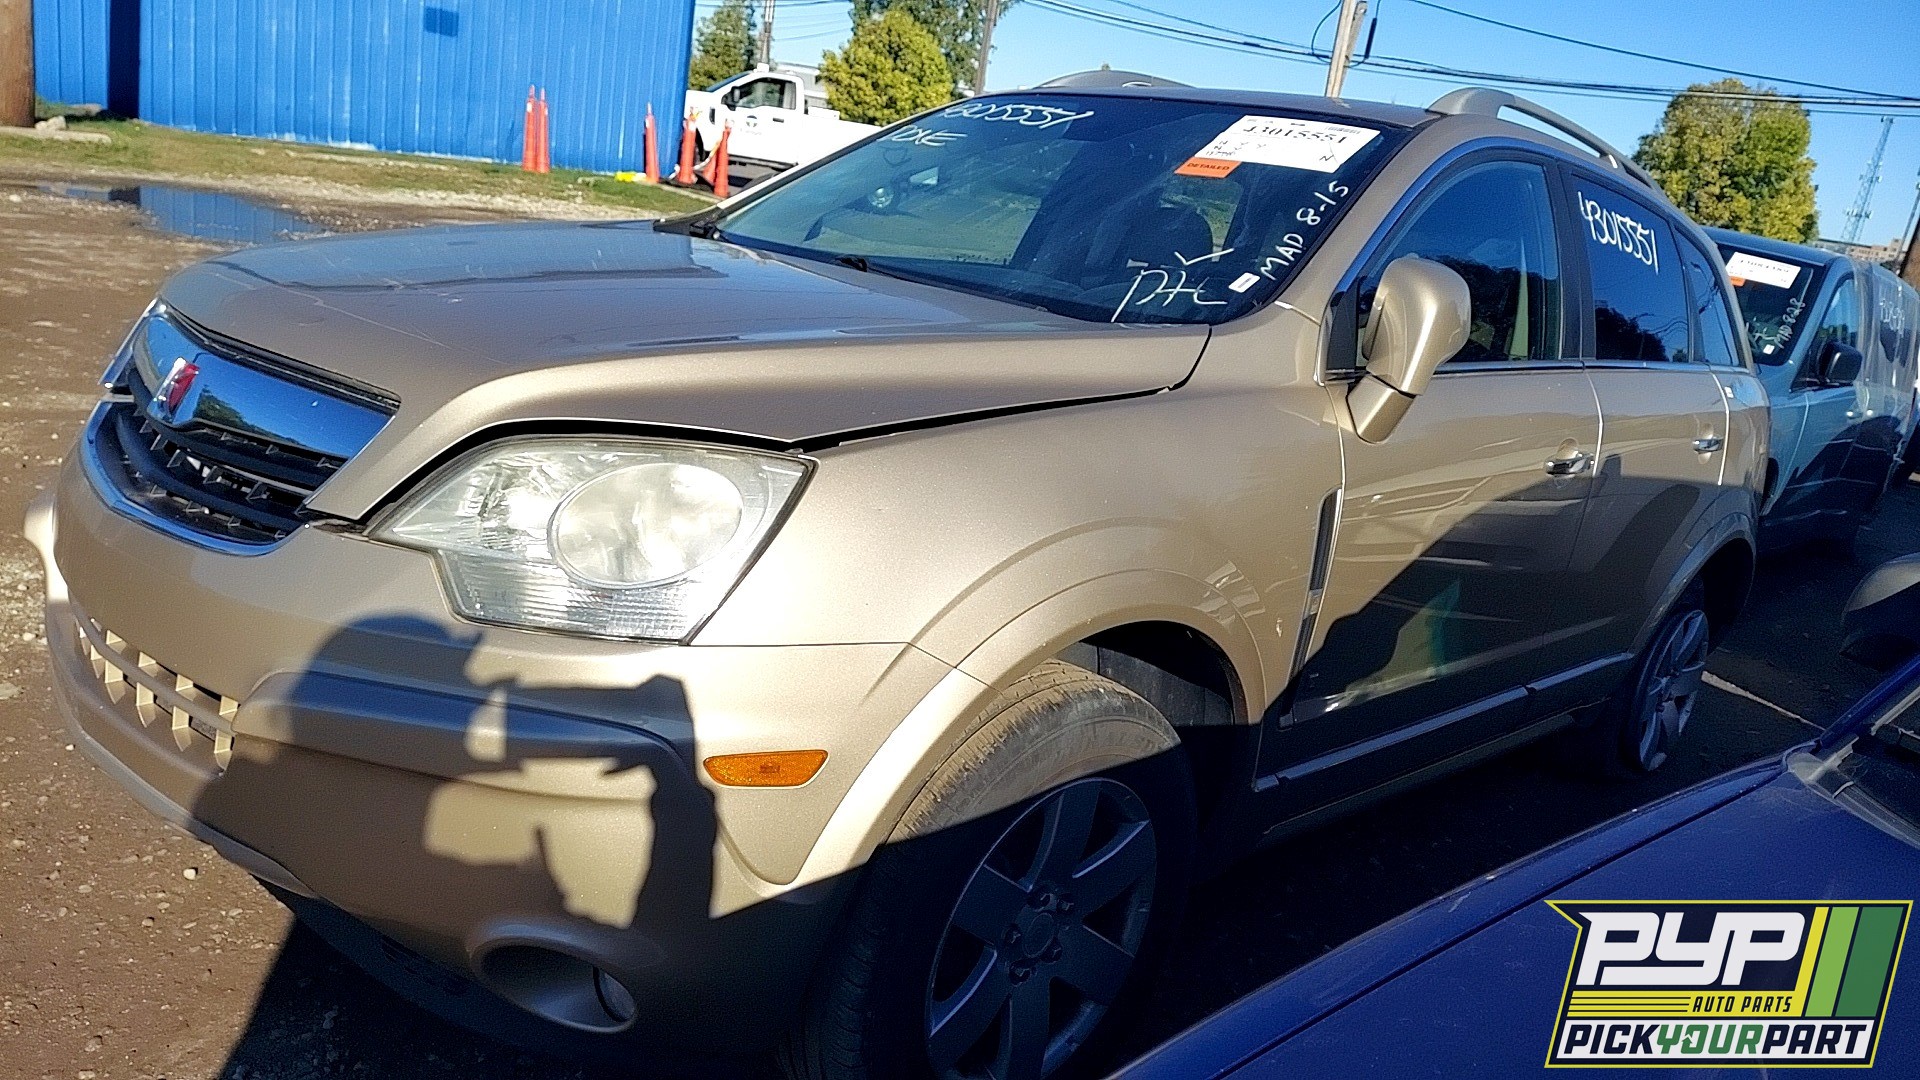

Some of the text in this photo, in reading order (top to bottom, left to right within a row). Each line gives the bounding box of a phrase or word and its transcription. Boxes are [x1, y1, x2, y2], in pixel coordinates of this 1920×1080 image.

[1187, 162, 1230, 171] DETAILED
[1577, 190, 1659, 275] 43015551
[1260, 233, 1304, 280] MAD
